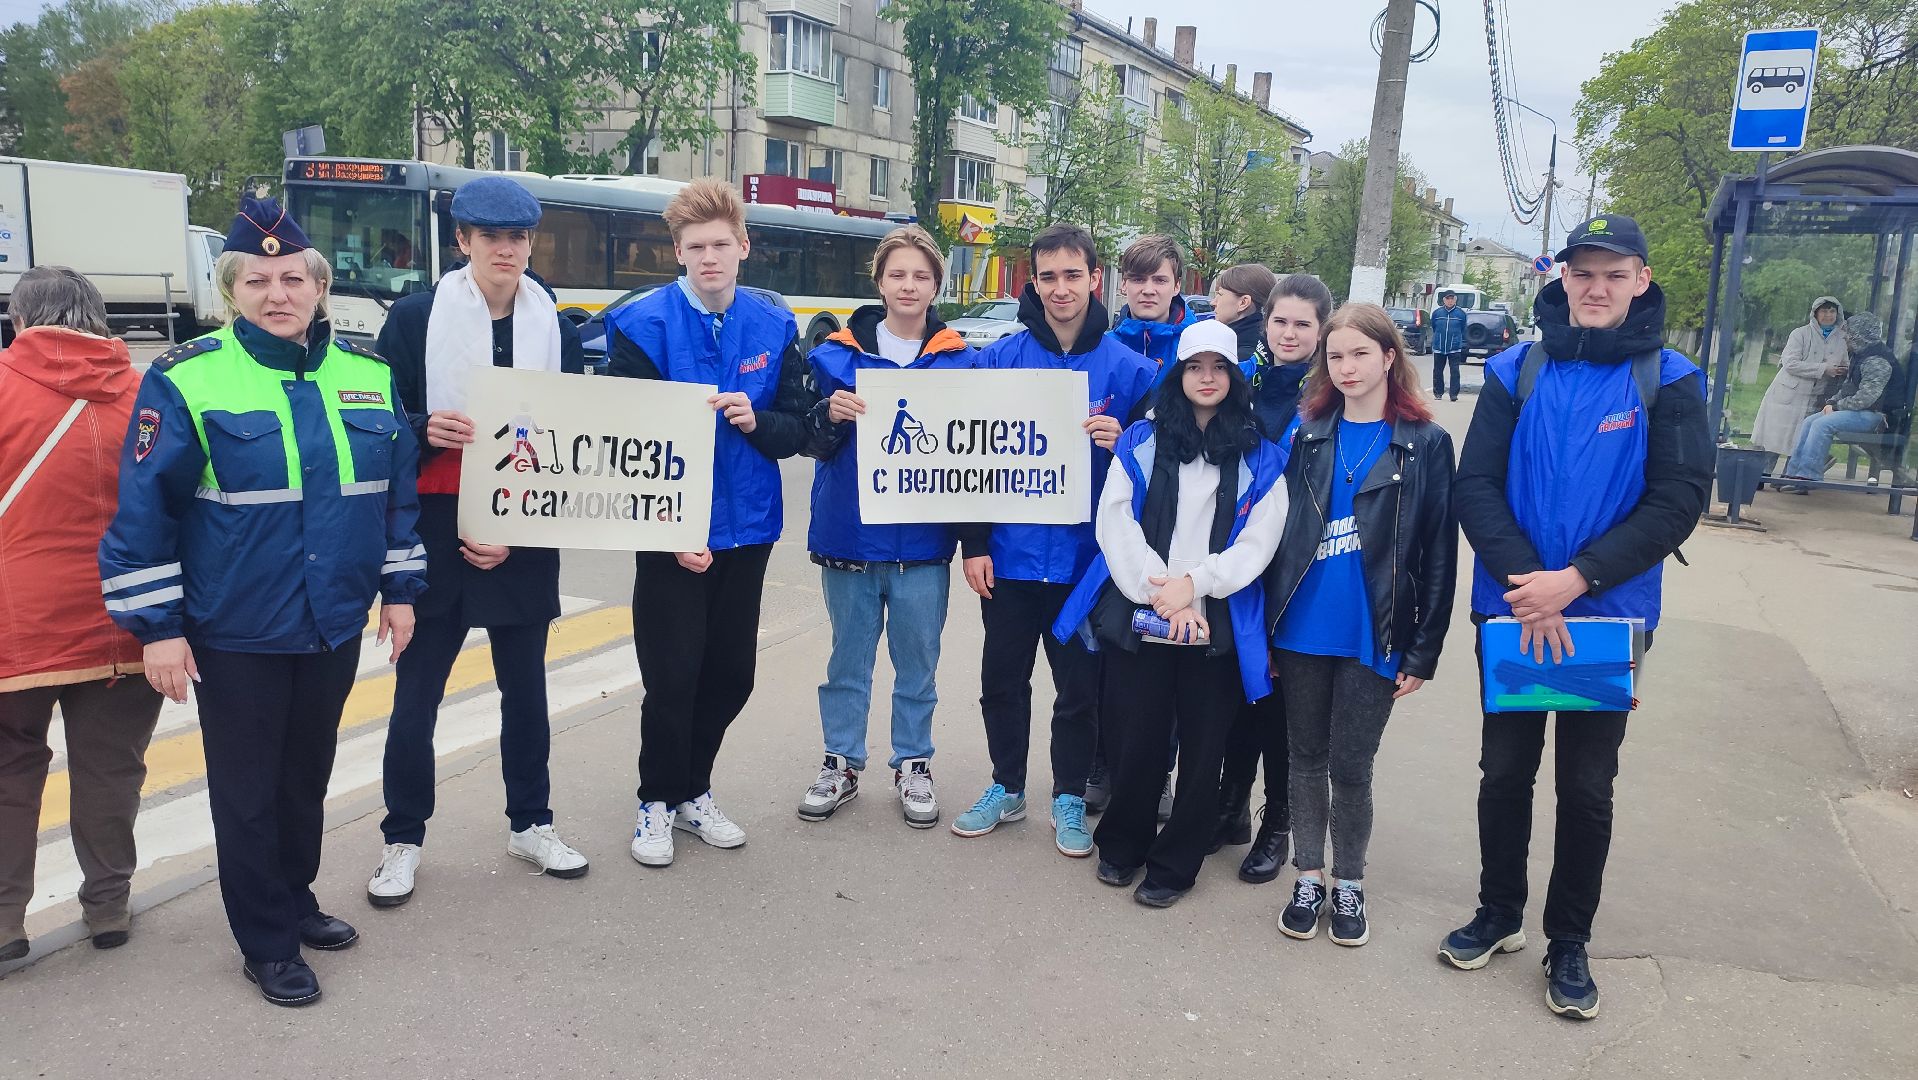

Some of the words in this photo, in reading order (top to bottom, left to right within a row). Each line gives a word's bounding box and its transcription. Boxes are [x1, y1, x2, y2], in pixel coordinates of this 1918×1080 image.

[872, 468, 888, 494] с
[898, 464, 1066, 498] велосипеда!
[491, 487, 511, 516] с
[521, 488, 683, 523] самоката!
[1317, 533, 1361, 560] ВАРДИ
